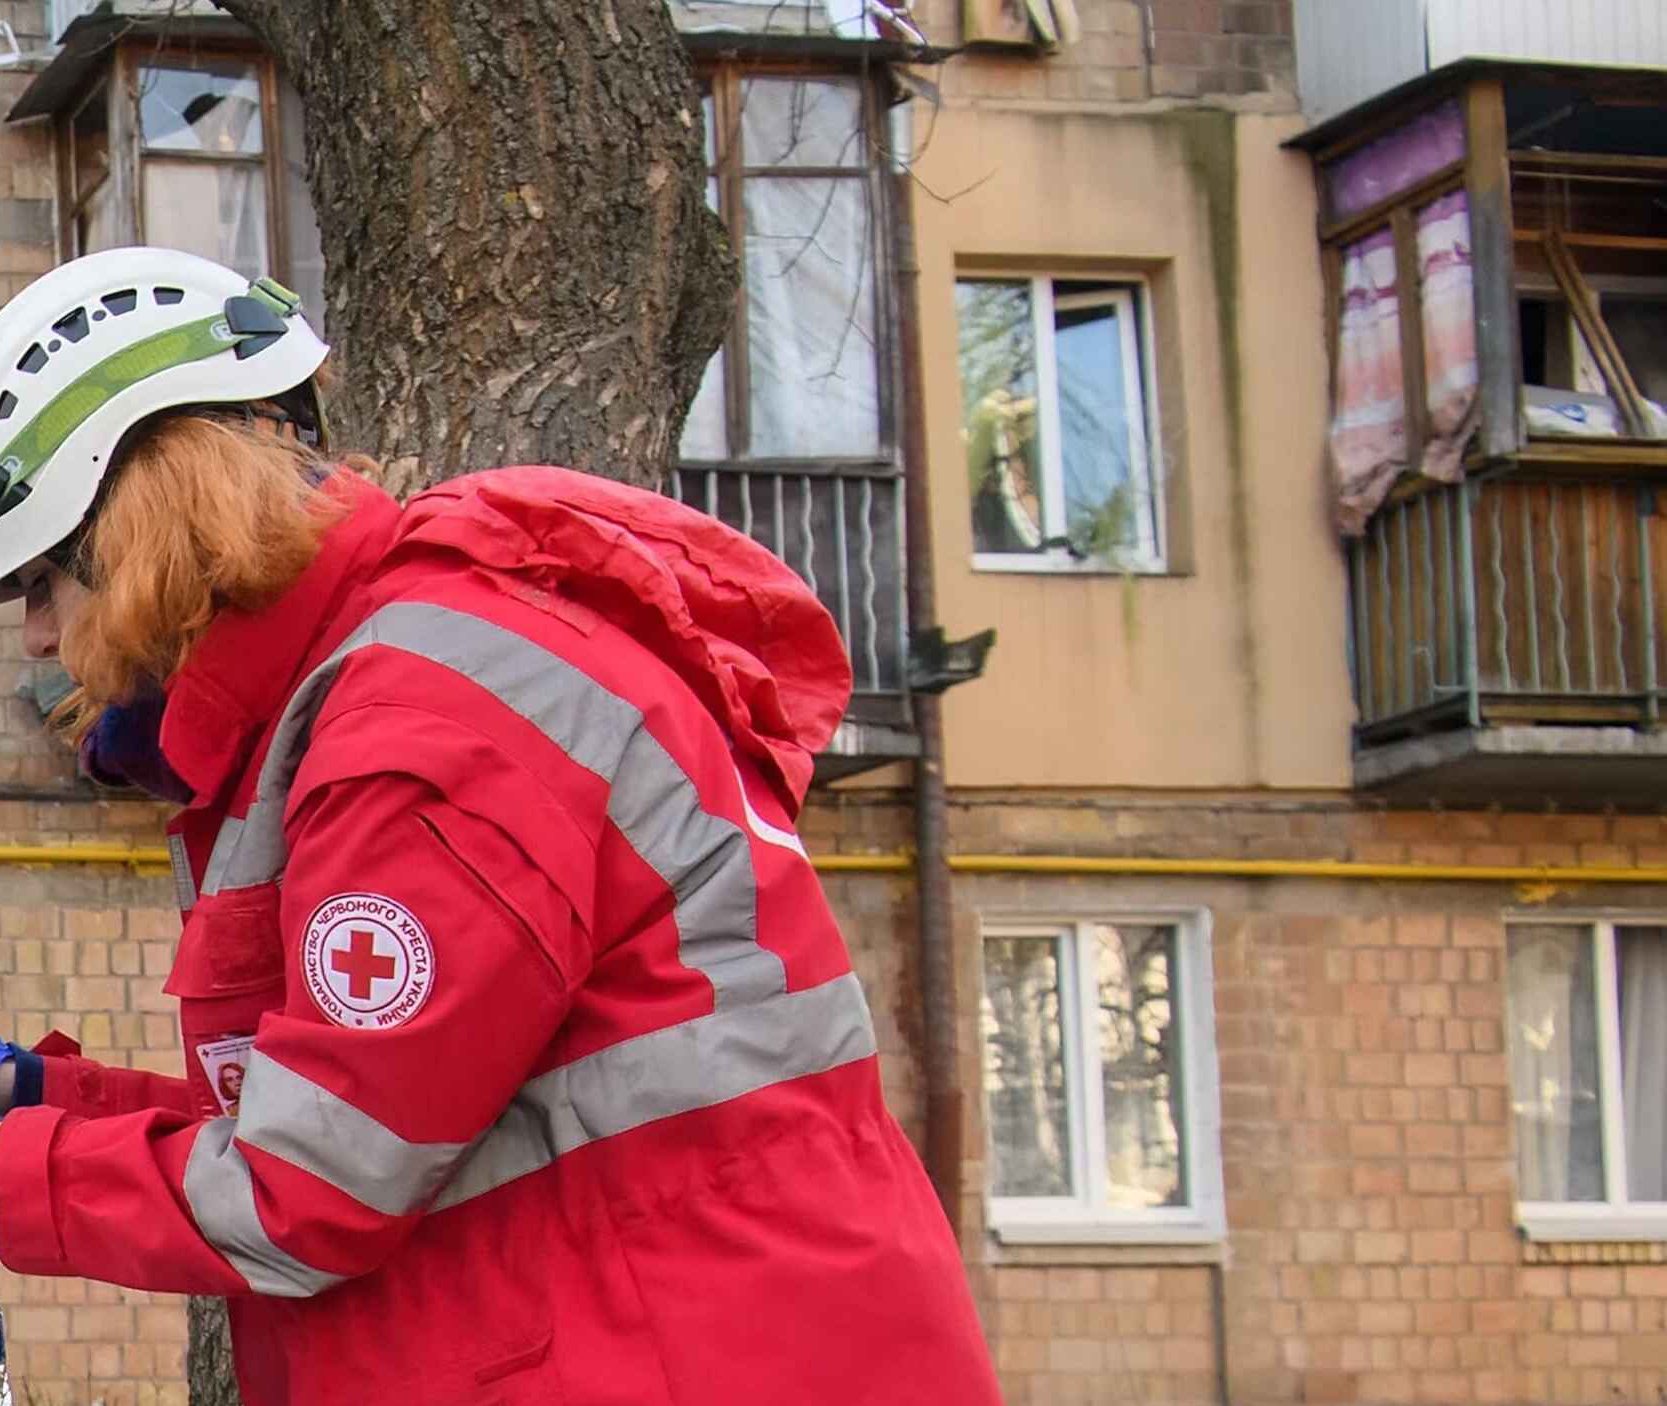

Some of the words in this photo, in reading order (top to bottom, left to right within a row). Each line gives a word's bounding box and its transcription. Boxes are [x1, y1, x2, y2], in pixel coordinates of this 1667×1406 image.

[316, 900, 397, 926] ЧЕРВОНОГО
[398, 918, 427, 975] ХРЕСТА
[307, 929, 343, 1019] ТОВАРИСТВО
[376, 980, 424, 1026] УКРАЇНИ
